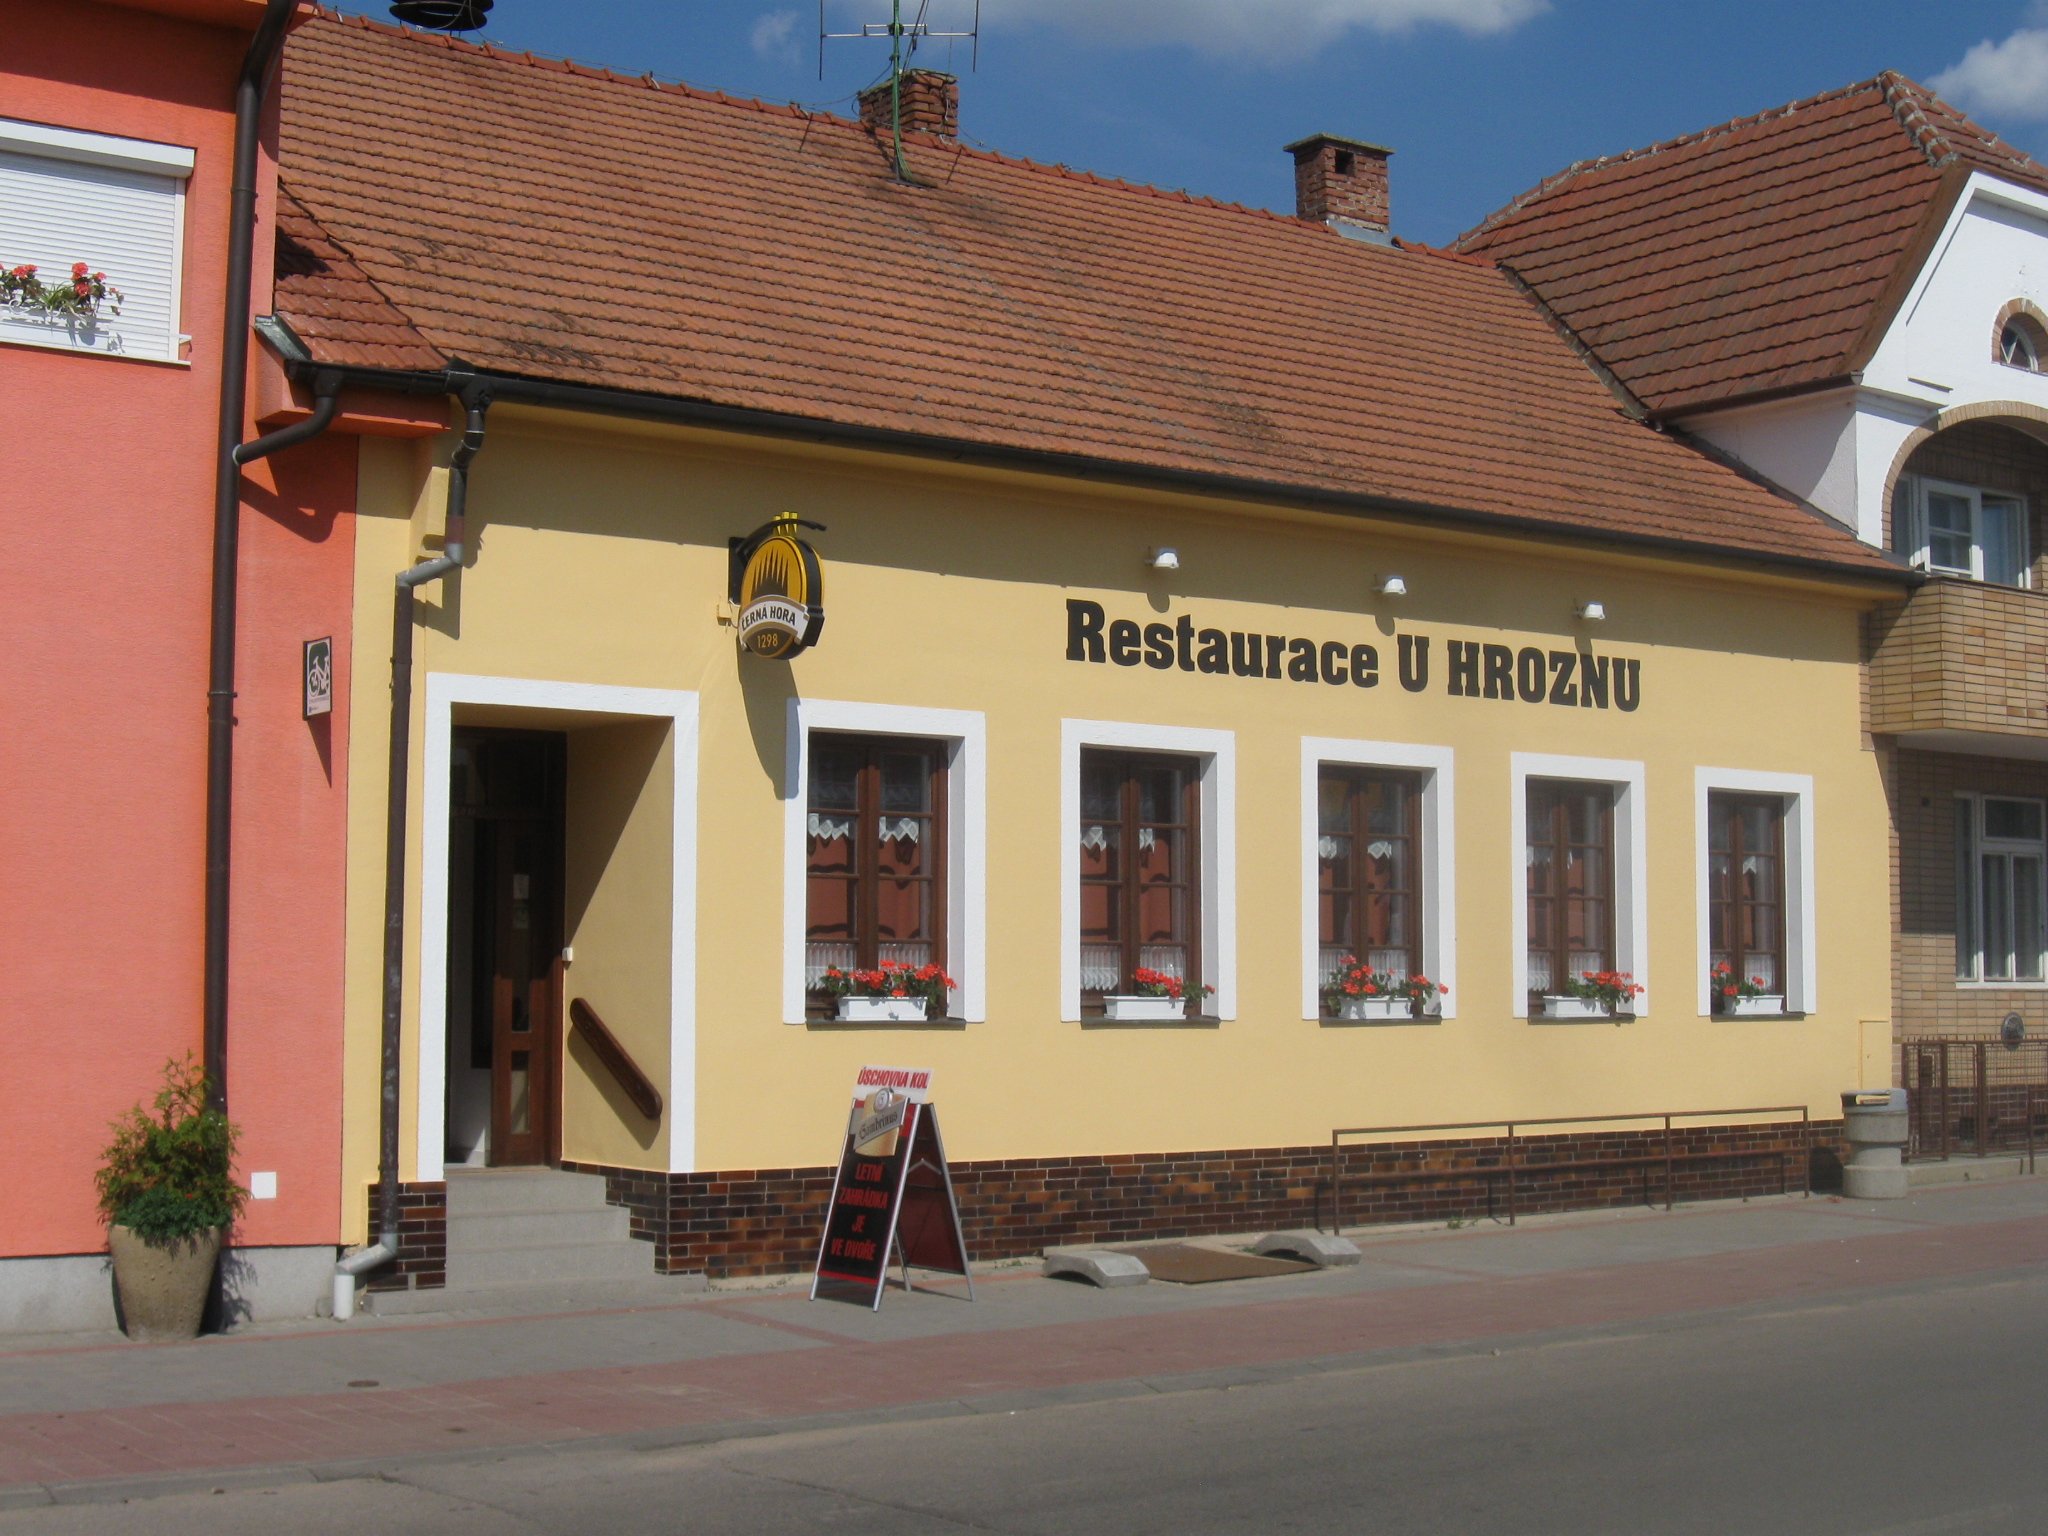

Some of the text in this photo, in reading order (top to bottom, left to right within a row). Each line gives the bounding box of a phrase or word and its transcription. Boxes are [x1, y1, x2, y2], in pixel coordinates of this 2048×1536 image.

[741, 604, 796, 631] ČERNÁ HORA
[757, 633, 779, 649] 1298
[1066, 598, 1641, 713] Restaurace U HROZNU
[857, 1066, 929, 1088] ÚSCHOVNA KOL
[859, 1111, 898, 1140] Gambrinus
[852, 1215, 866, 1232] JE
[830, 1238, 844, 1255] VE
